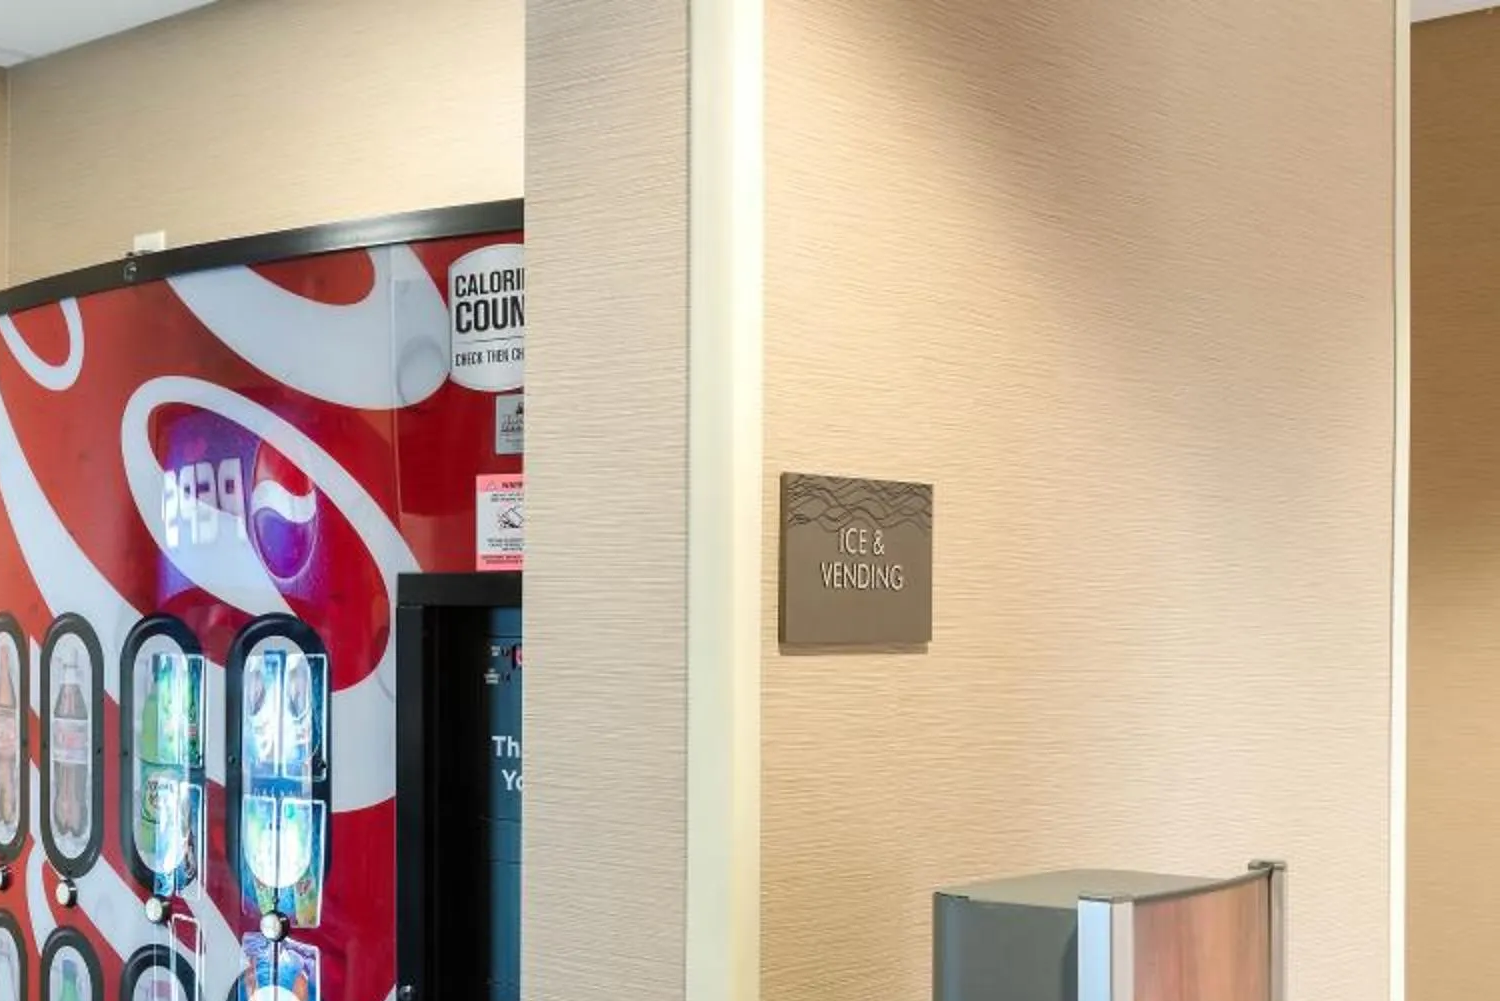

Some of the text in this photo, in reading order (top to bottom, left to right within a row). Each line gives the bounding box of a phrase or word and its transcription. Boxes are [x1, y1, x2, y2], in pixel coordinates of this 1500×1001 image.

[455, 352, 482, 366] CHECK
[487, 349, 508, 363] THEN
[838, 527, 885, 555] ICE &
[820, 561, 904, 591] VENDING
